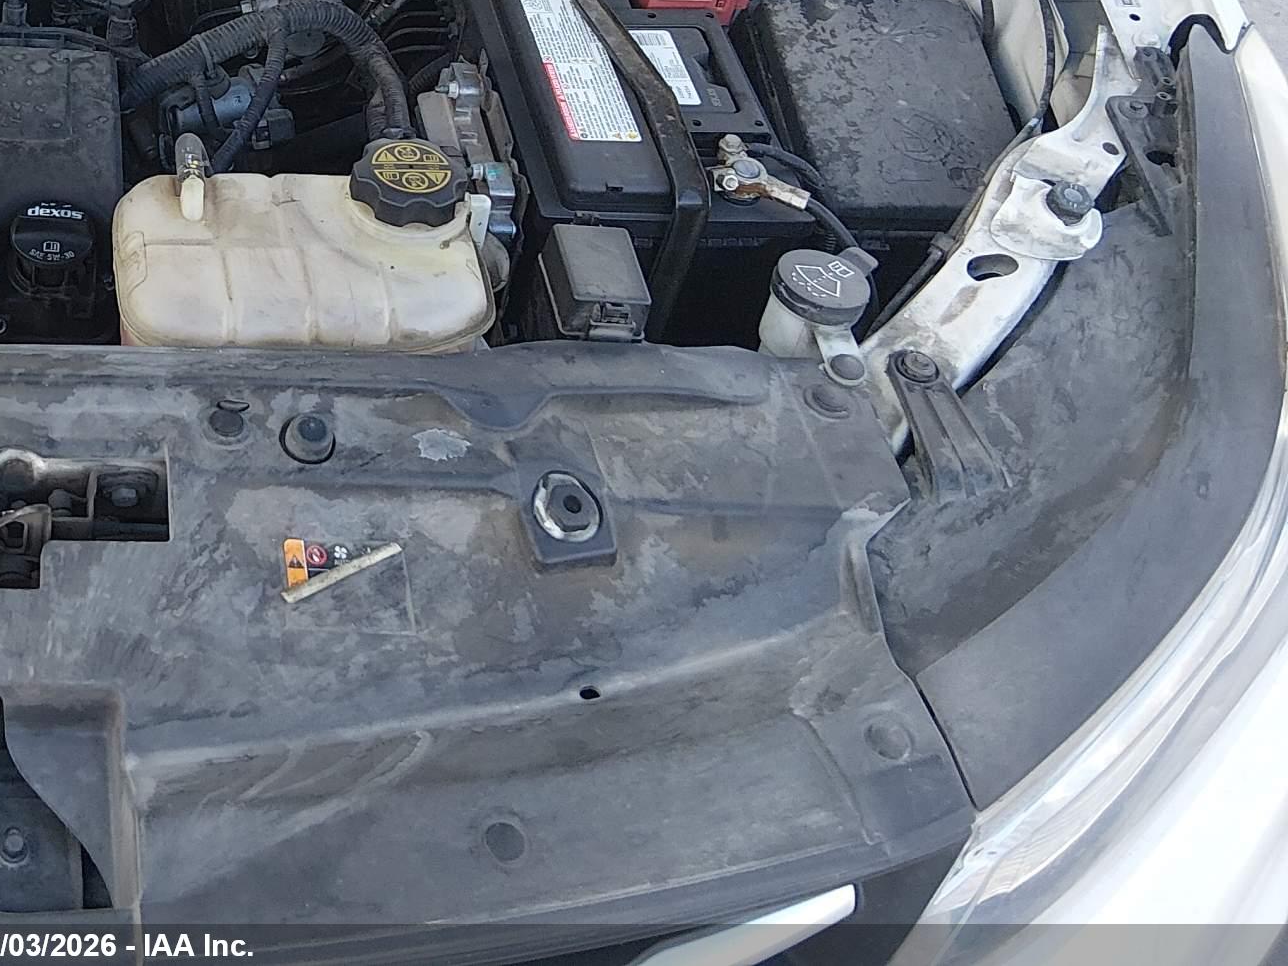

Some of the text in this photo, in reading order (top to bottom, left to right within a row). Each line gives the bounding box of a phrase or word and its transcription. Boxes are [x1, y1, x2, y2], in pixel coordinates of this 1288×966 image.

[27, 206, 84, 220] dexos
[29, 249, 75, 261] SAE 5W-30
